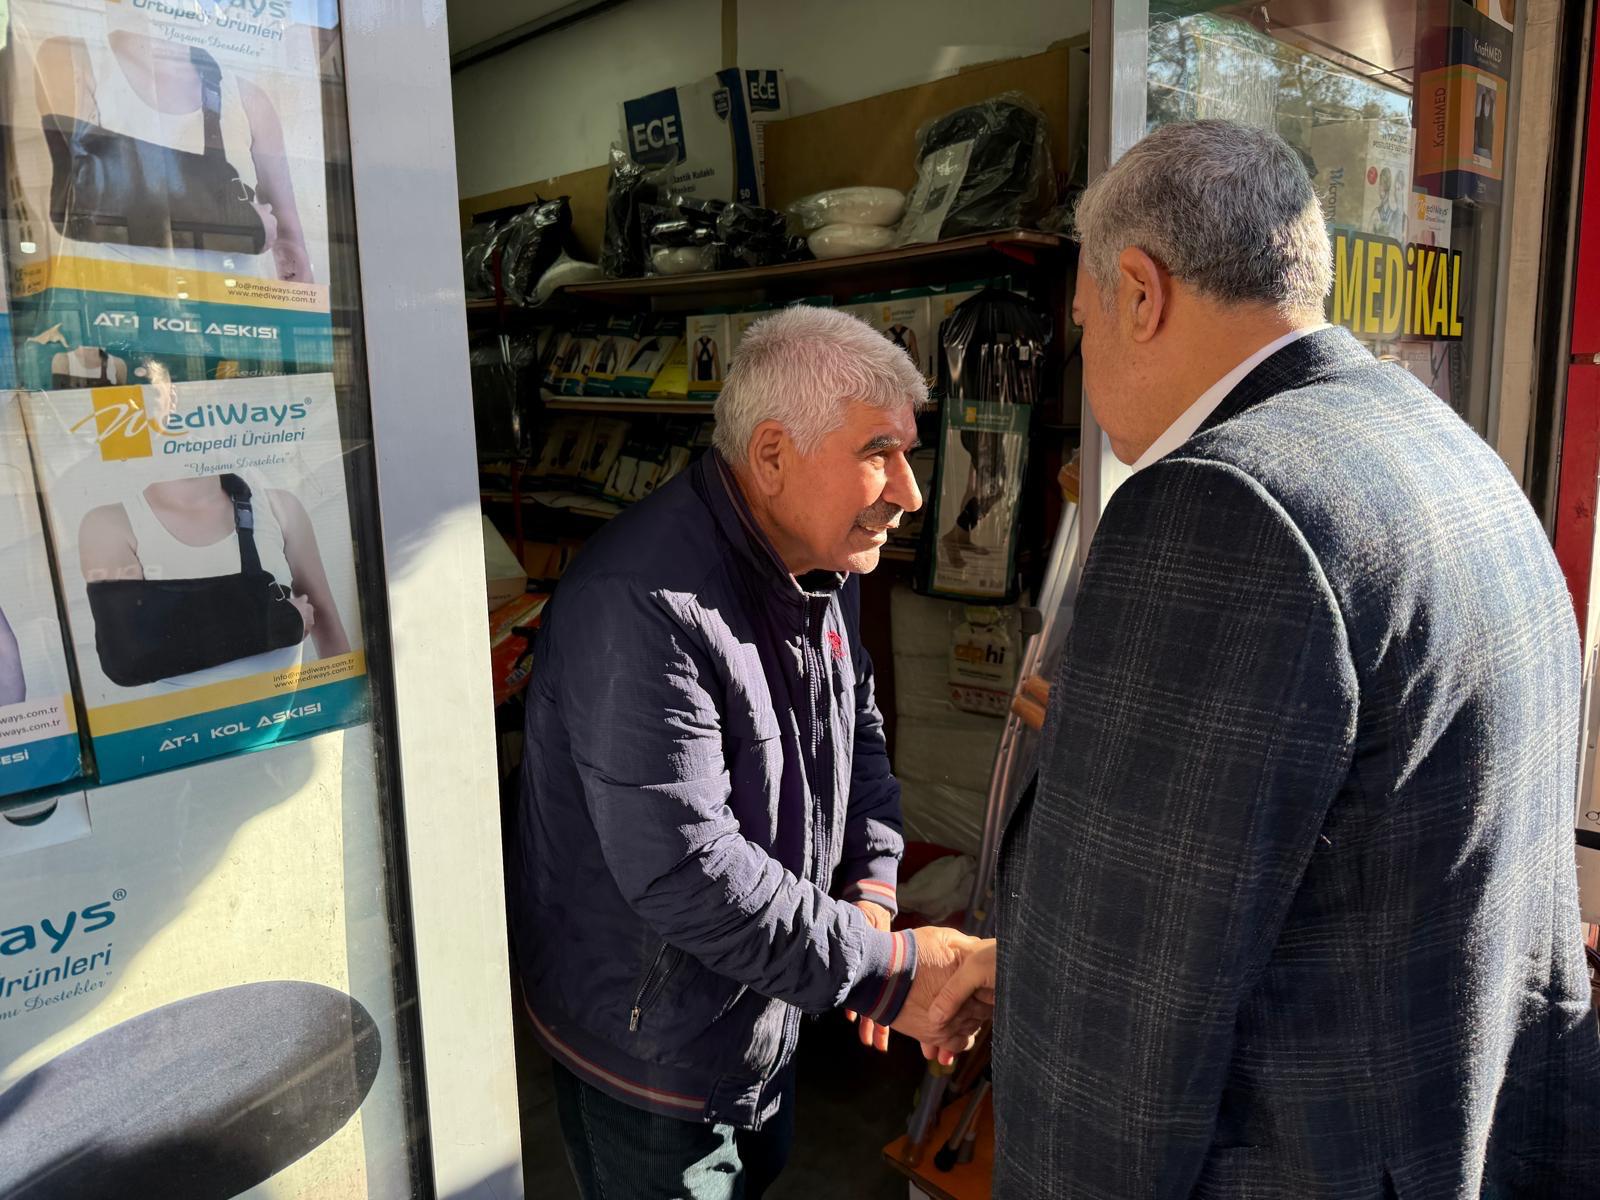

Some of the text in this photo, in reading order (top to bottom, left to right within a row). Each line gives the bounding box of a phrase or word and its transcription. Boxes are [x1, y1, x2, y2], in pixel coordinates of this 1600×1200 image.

[750, 82, 776, 99] ECE
[632, 115, 679, 153] ECE
[93, 313, 278, 339] AT-1 KOL ASKISI
[163, 428, 305, 455] Ortopedi Ürünleri
[159, 703, 321, 752] AT-1 KOL ASKISI
